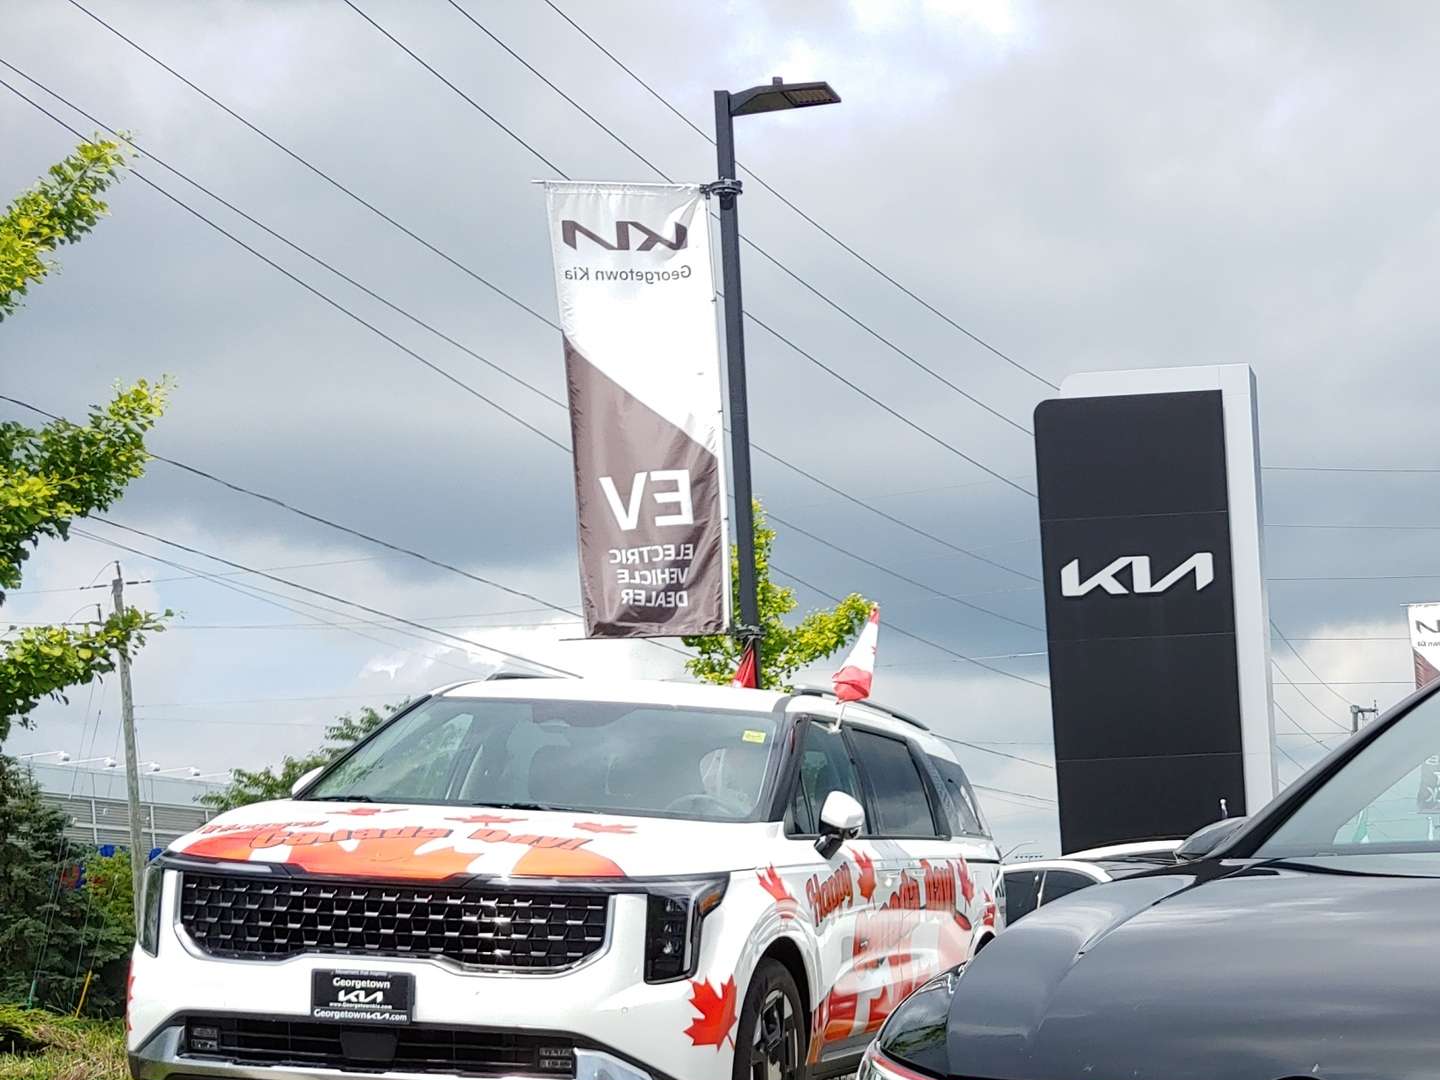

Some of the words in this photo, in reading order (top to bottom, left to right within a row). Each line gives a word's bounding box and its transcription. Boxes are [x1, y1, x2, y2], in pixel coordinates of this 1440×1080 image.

[1060, 551, 1214, 597] KIA
[332, 977, 391, 989] Georgetown
[337, 989, 384, 1003] KIA
